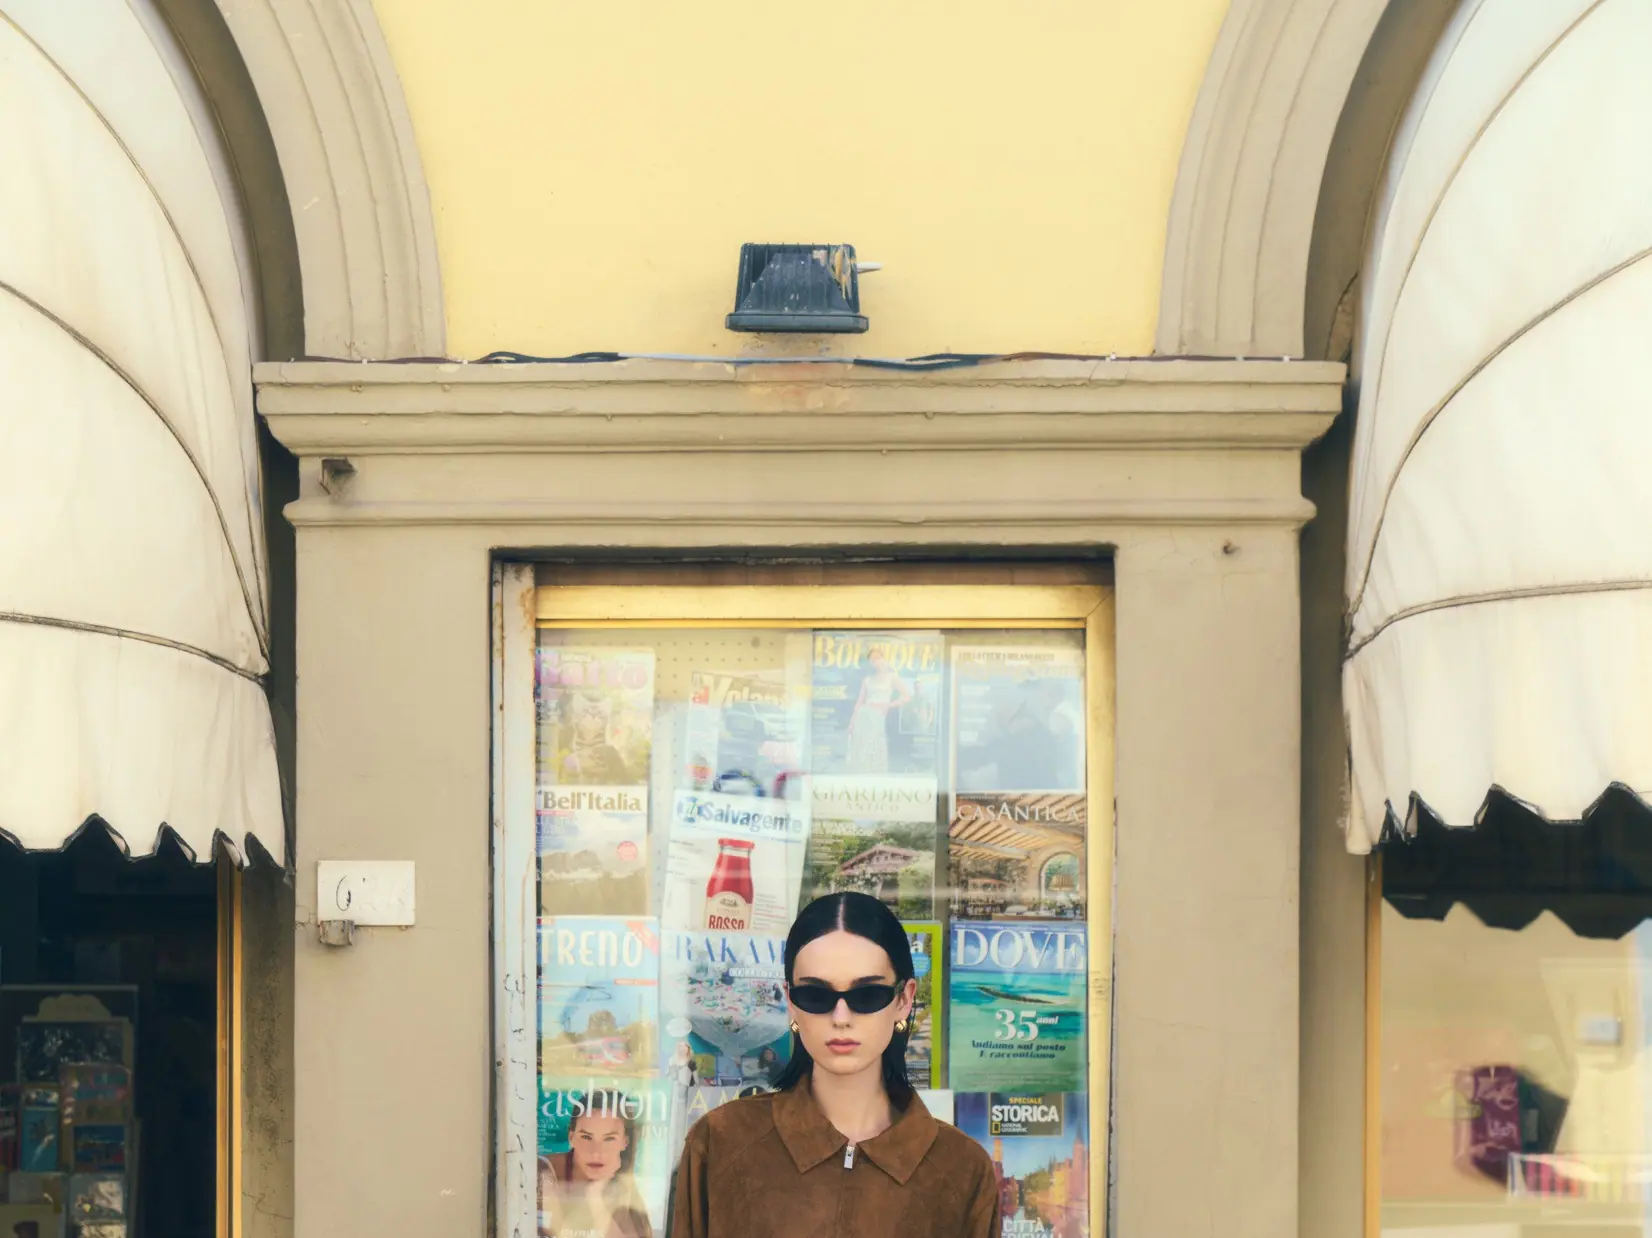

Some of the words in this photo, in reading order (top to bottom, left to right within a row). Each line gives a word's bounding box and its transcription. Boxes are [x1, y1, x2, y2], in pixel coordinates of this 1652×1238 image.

[813, 787, 932, 804] GIARDINO
[702, 802, 803, 834] Salvagente
[953, 928, 1086, 971] DOVE
[994, 1008, 1039, 1042] 35
[1036, 1016, 1059, 1025] anni
[540, 1078, 668, 1121] ashion
[991, 1105, 1060, 1123] STORICA
[1003, 1217, 1045, 1233] CITTÀ
